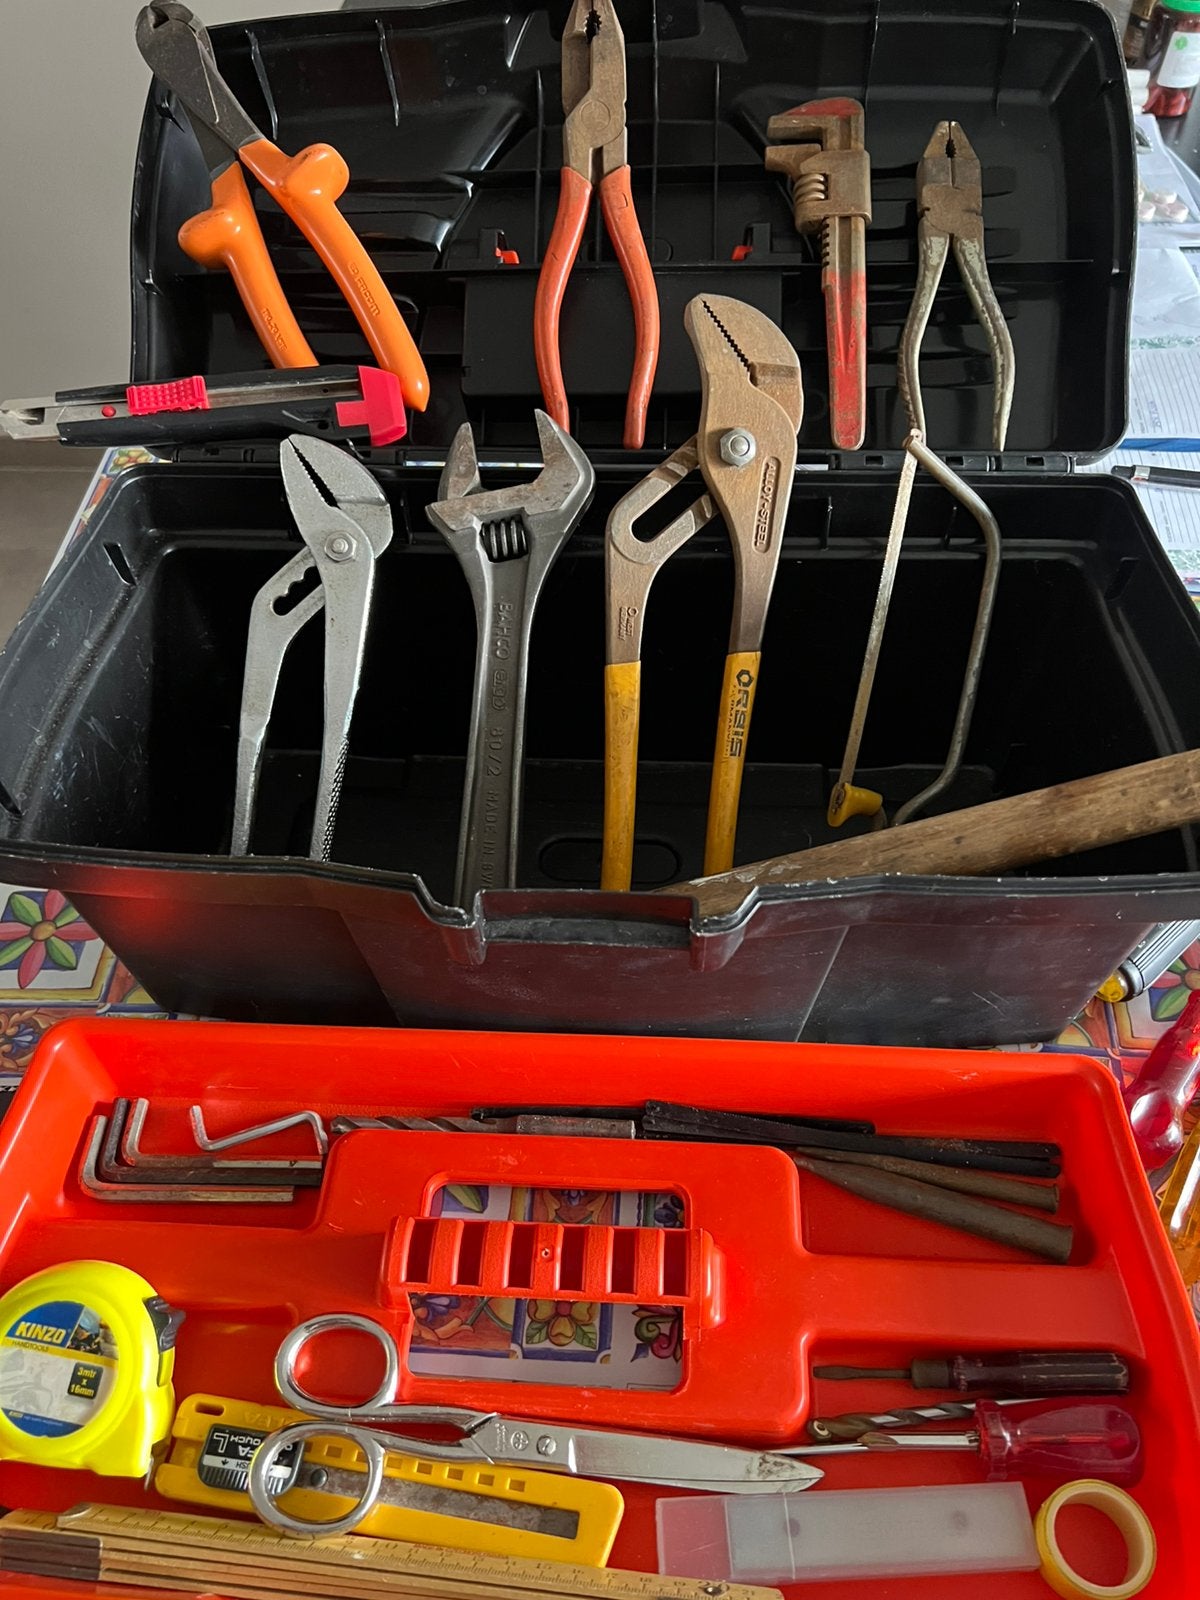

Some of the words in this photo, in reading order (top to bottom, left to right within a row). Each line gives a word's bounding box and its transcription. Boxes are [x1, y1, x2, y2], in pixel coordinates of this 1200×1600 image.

[754, 461, 776, 548] ALLOY-STEEL
[496, 602, 513, 661] BAHCO
[483, 790, 499, 835] MADE
[482, 839, 497, 856] IN
[15, 1321, 67, 1344] KINZO
[12, 1340, 49, 1352] HANDTOOLS
[77, 1366, 97, 1378] 3mtr
[70, 1384, 95, 1397] 16mm
[213, 1432, 230, 1453] L
[230, 1434, 262, 1446] OUCH
